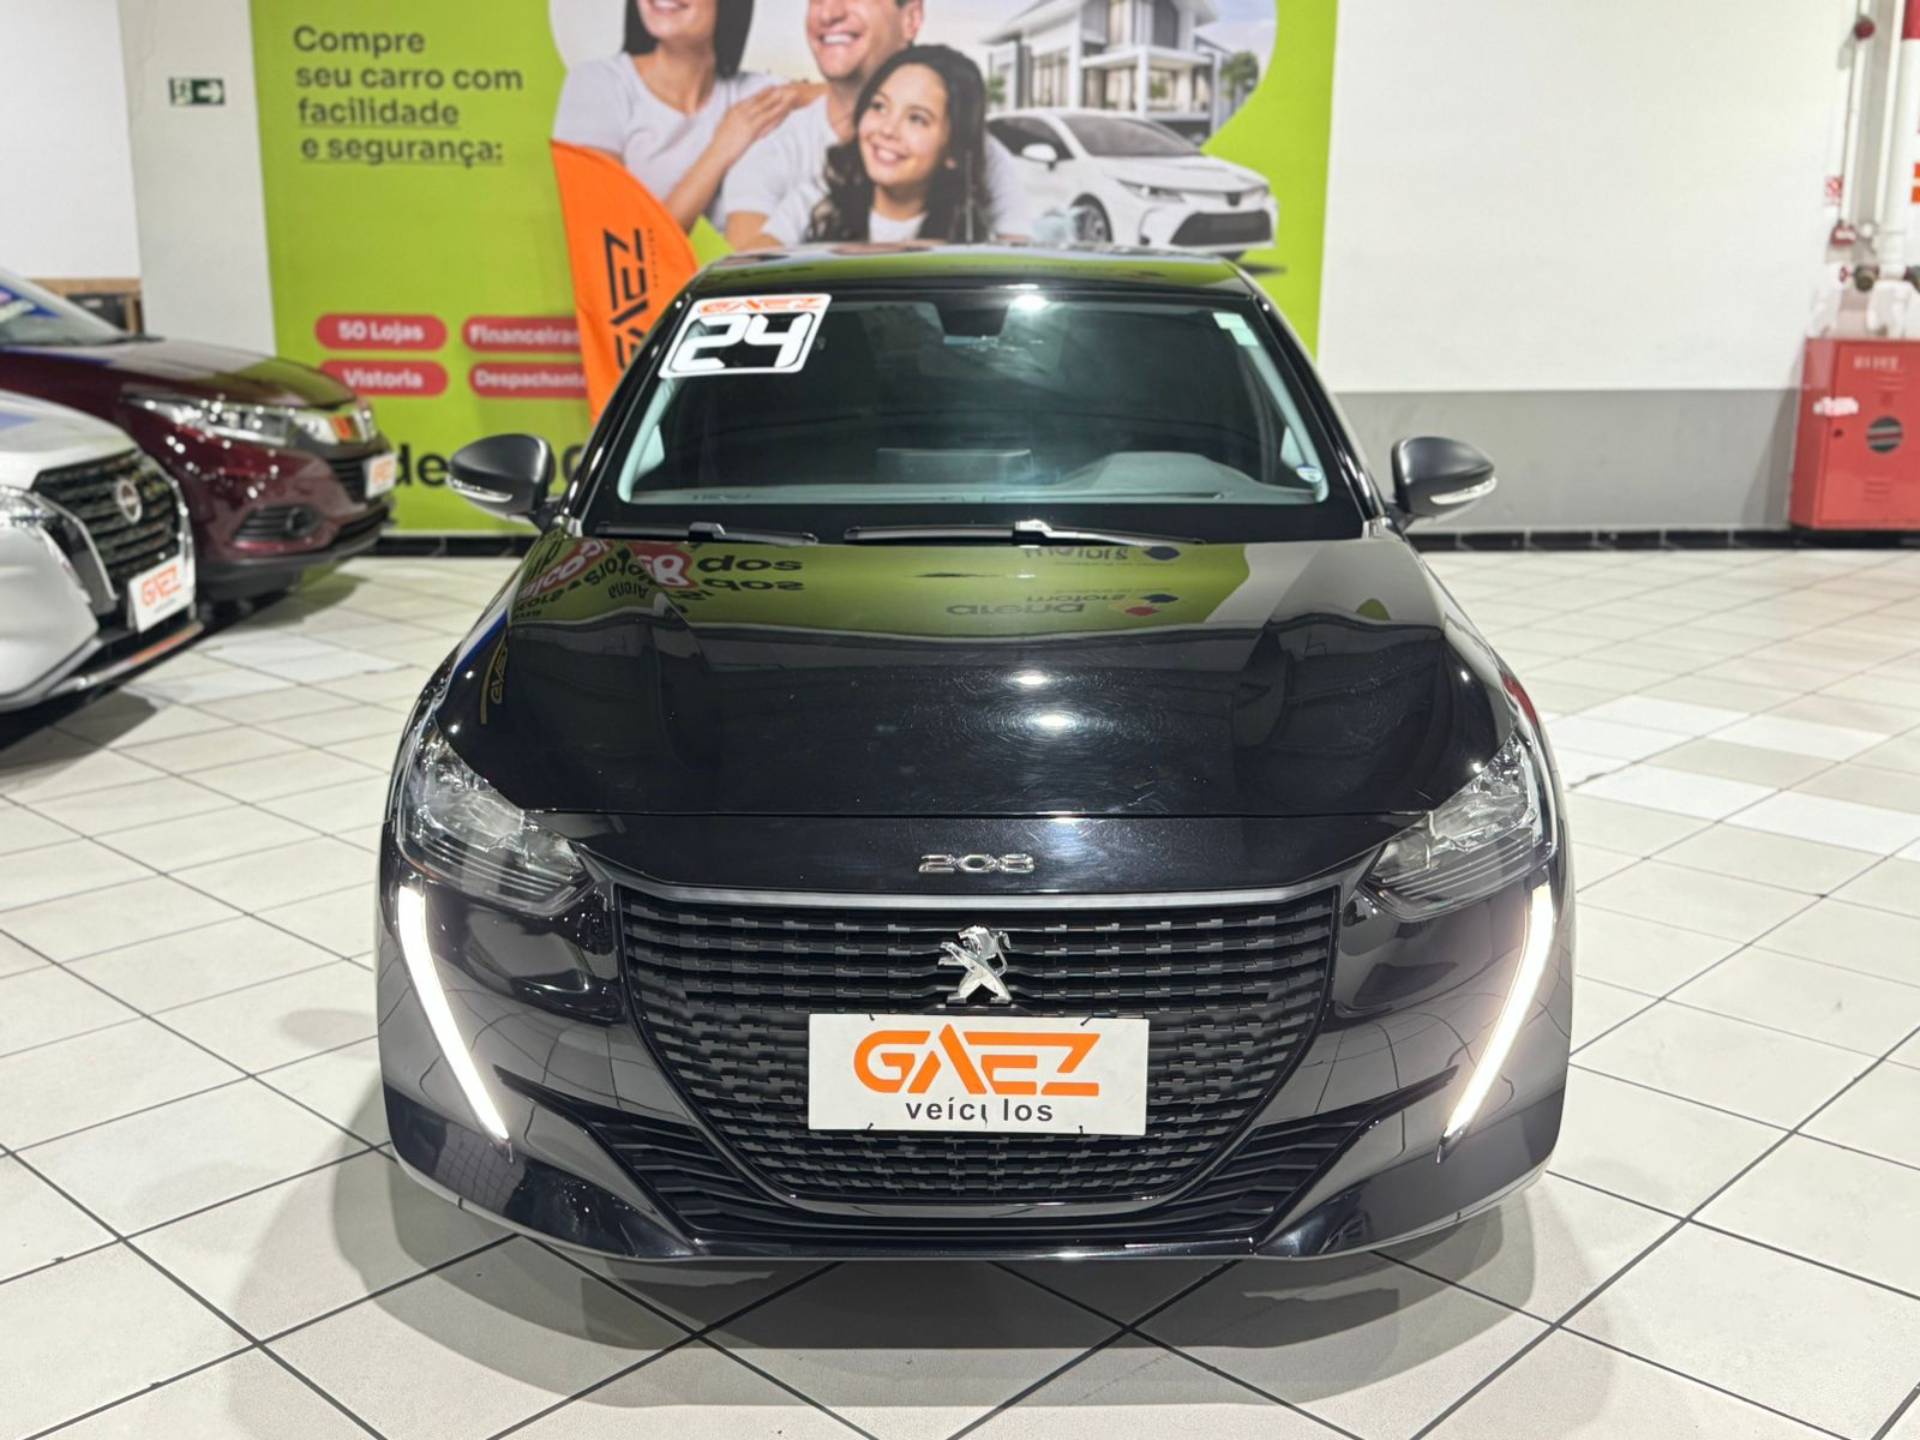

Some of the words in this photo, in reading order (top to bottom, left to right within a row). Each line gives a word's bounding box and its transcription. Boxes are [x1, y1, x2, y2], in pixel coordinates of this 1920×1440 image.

[293, 25, 425, 59] Compre
[296, 66, 352, 88] seu
[361, 67, 445, 89] carro
[453, 68, 523, 90] com
[299, 97, 459, 125] facilidade
[302, 137, 319, 159] e
[327, 137, 503, 168] segurança:
[337, 320, 367, 341] 50
[369, 320, 425, 346] Lojas
[668, 314, 814, 370] 24
[341, 367, 423, 389] Vistoria
[919, 853, 1035, 874] 208
[853, 1023, 1101, 1097] GAEZ
